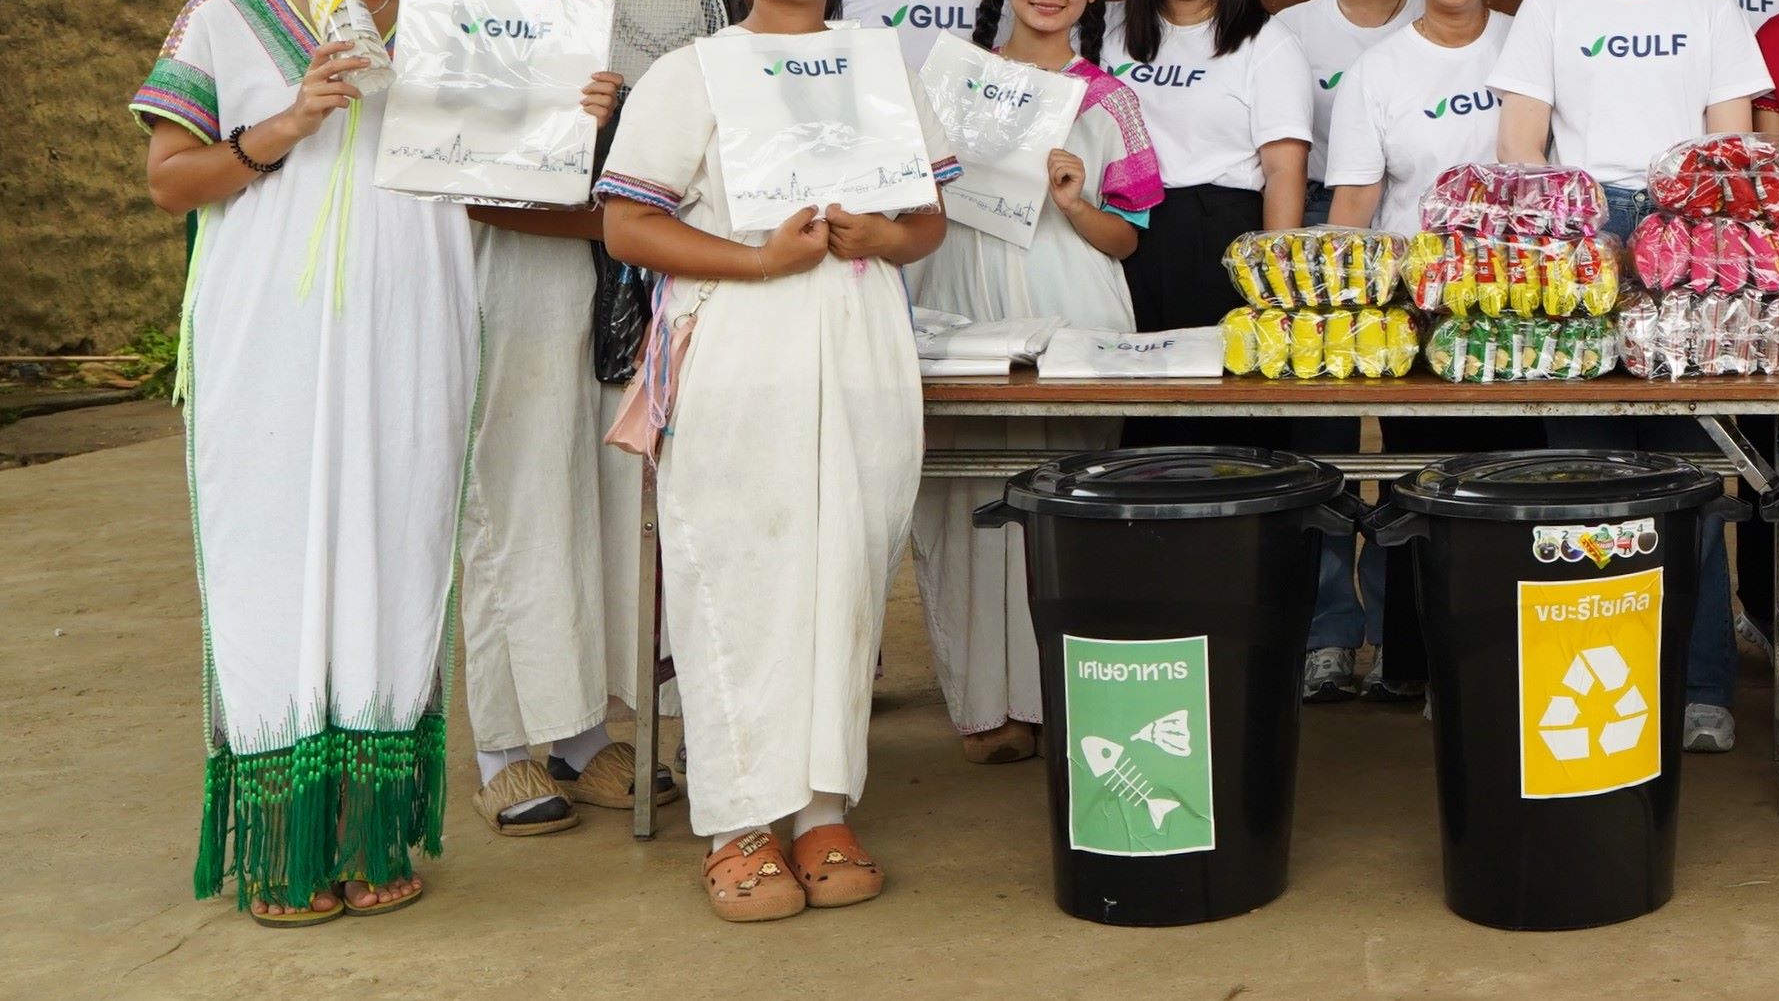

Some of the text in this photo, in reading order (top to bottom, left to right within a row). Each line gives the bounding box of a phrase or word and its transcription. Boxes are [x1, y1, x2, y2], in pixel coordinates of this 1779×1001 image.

[909, 4, 978, 30] GUL
[483, 18, 553, 40] GULF
[1607, 33, 1688, 58] GULF
[785, 57, 848, 77] GULF
[1131, 63, 1206, 88] GULF
[1117, 340, 1175, 354] GULF
[1534, 590, 1650, 622] ขยะรีไซเคิล
[1078, 660, 1189, 682] เศษอาหาร
